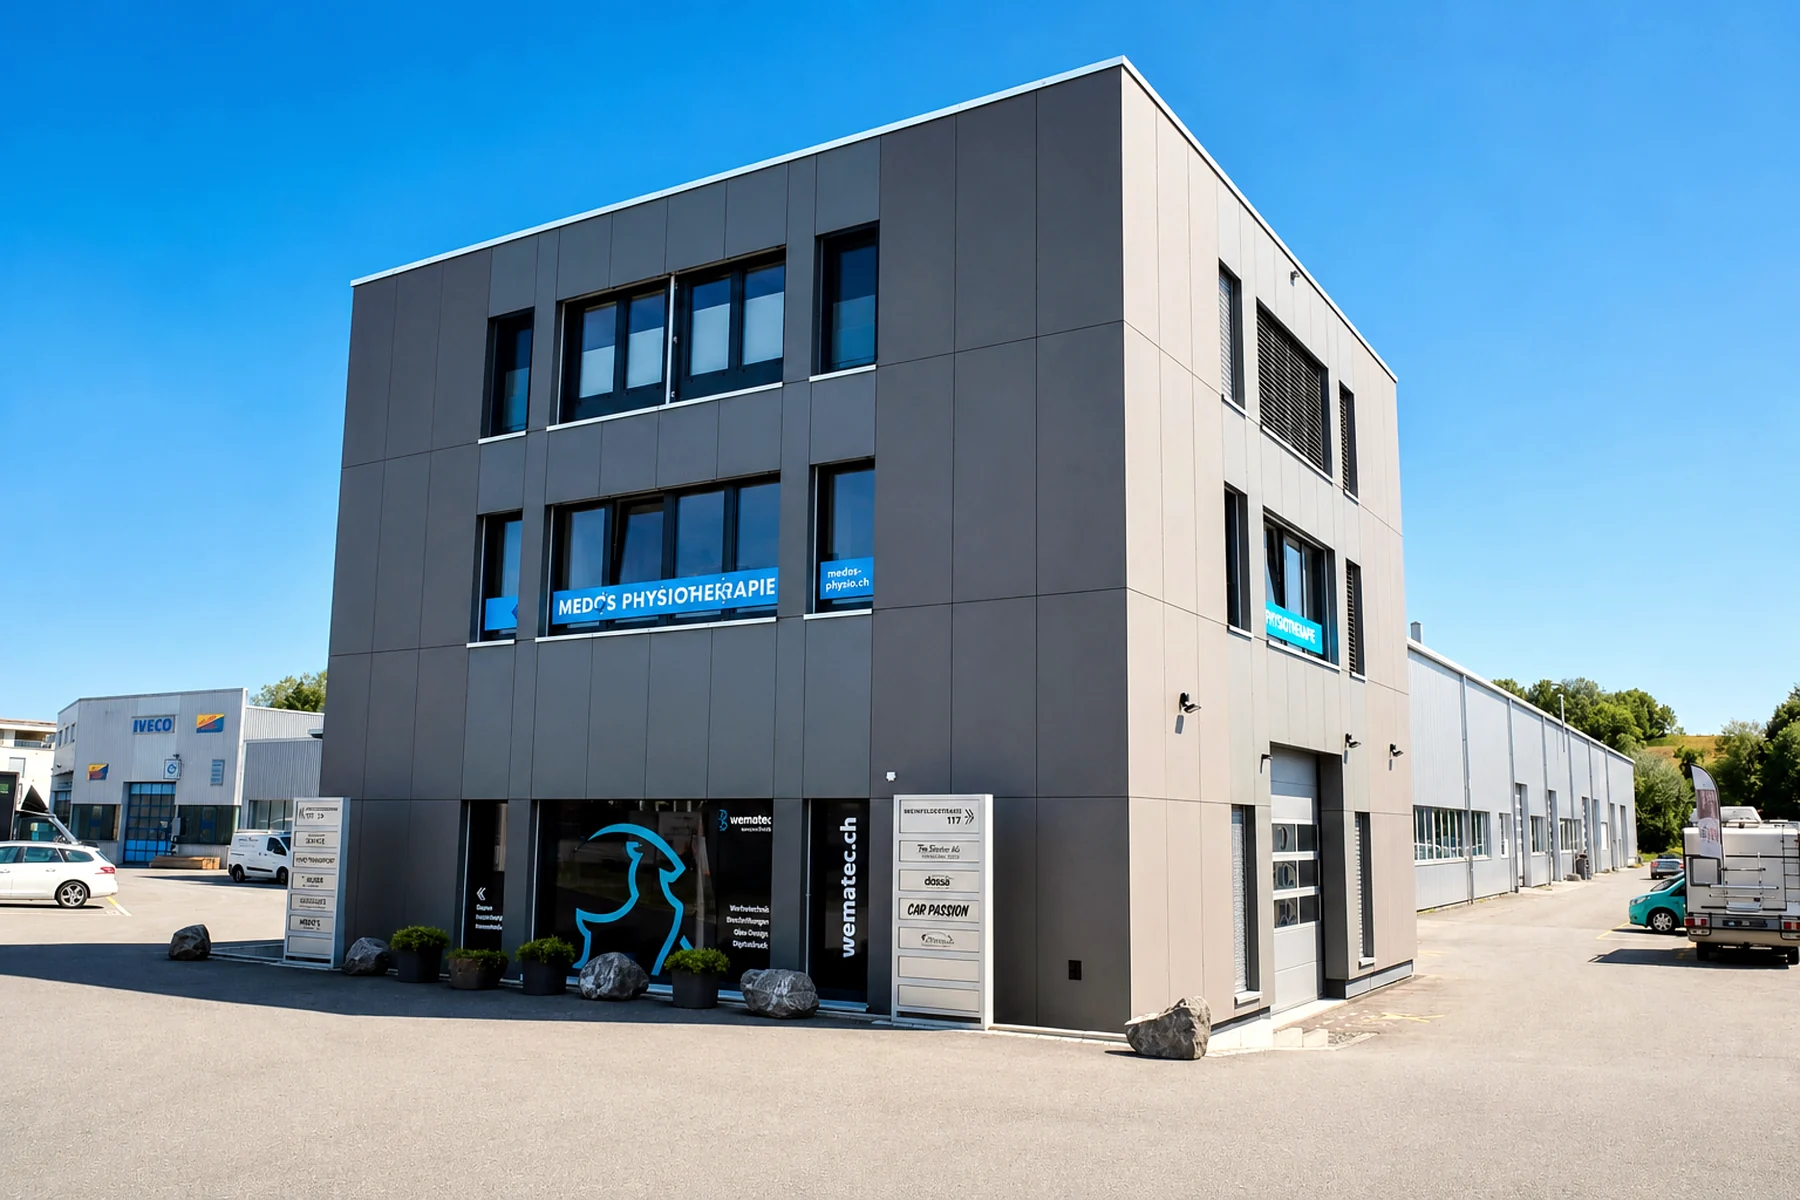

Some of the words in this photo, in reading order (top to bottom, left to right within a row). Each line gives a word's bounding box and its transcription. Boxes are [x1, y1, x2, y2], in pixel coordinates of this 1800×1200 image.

[133, 718, 173, 733] IVECO
[947, 816, 961, 824] 117
[840, 817, 857, 958] wematec.ch
[907, 903, 927, 916] CAR
[928, 903, 970, 917] PASSION
